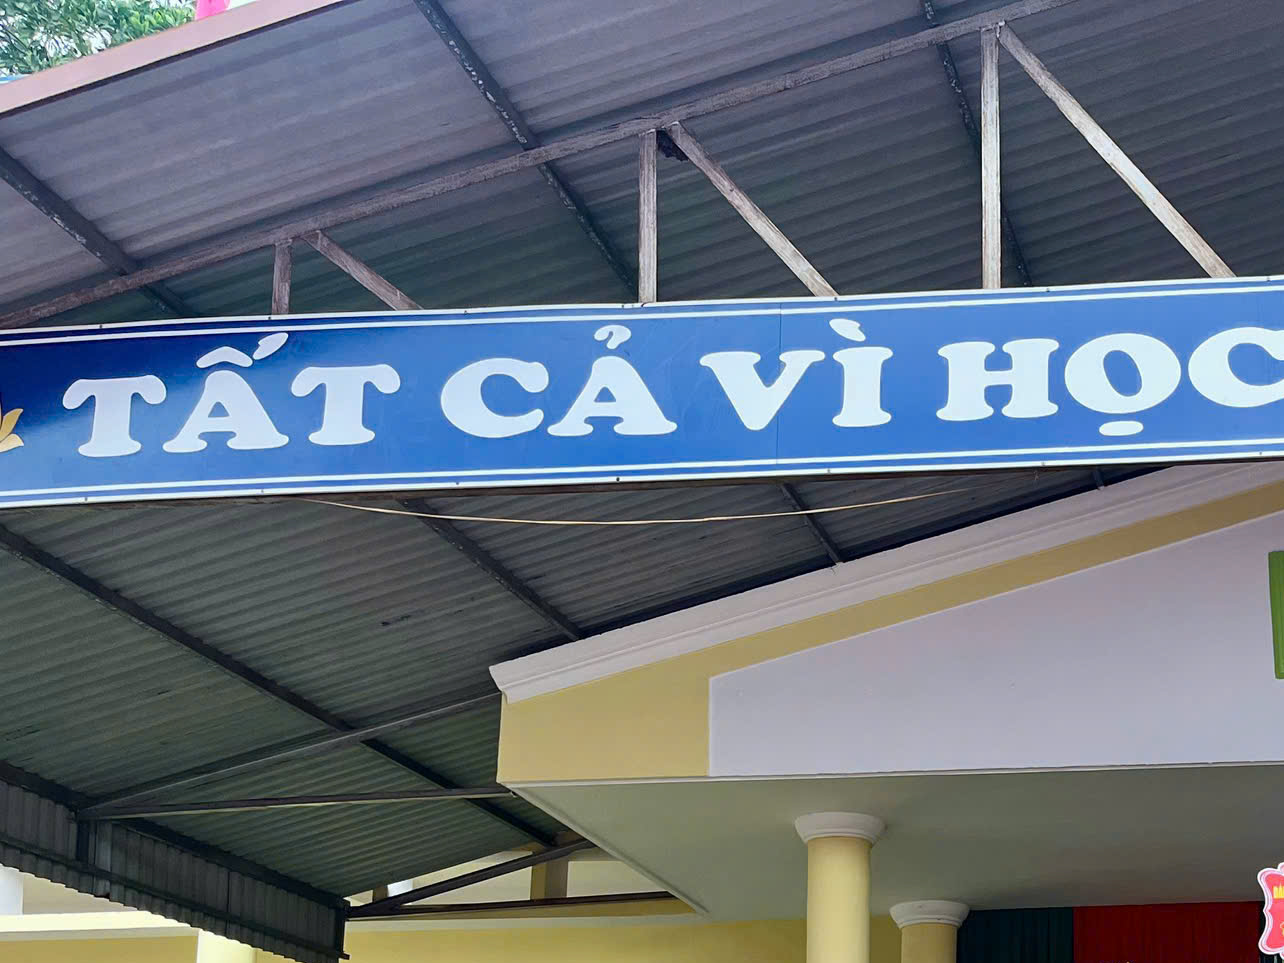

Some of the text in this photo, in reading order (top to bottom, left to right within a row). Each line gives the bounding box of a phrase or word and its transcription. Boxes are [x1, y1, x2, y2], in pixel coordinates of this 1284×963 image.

[62, 332, 401, 458] TẤT
[440, 324, 678, 439] CẢ
[699, 318, 893, 432] VÌ
